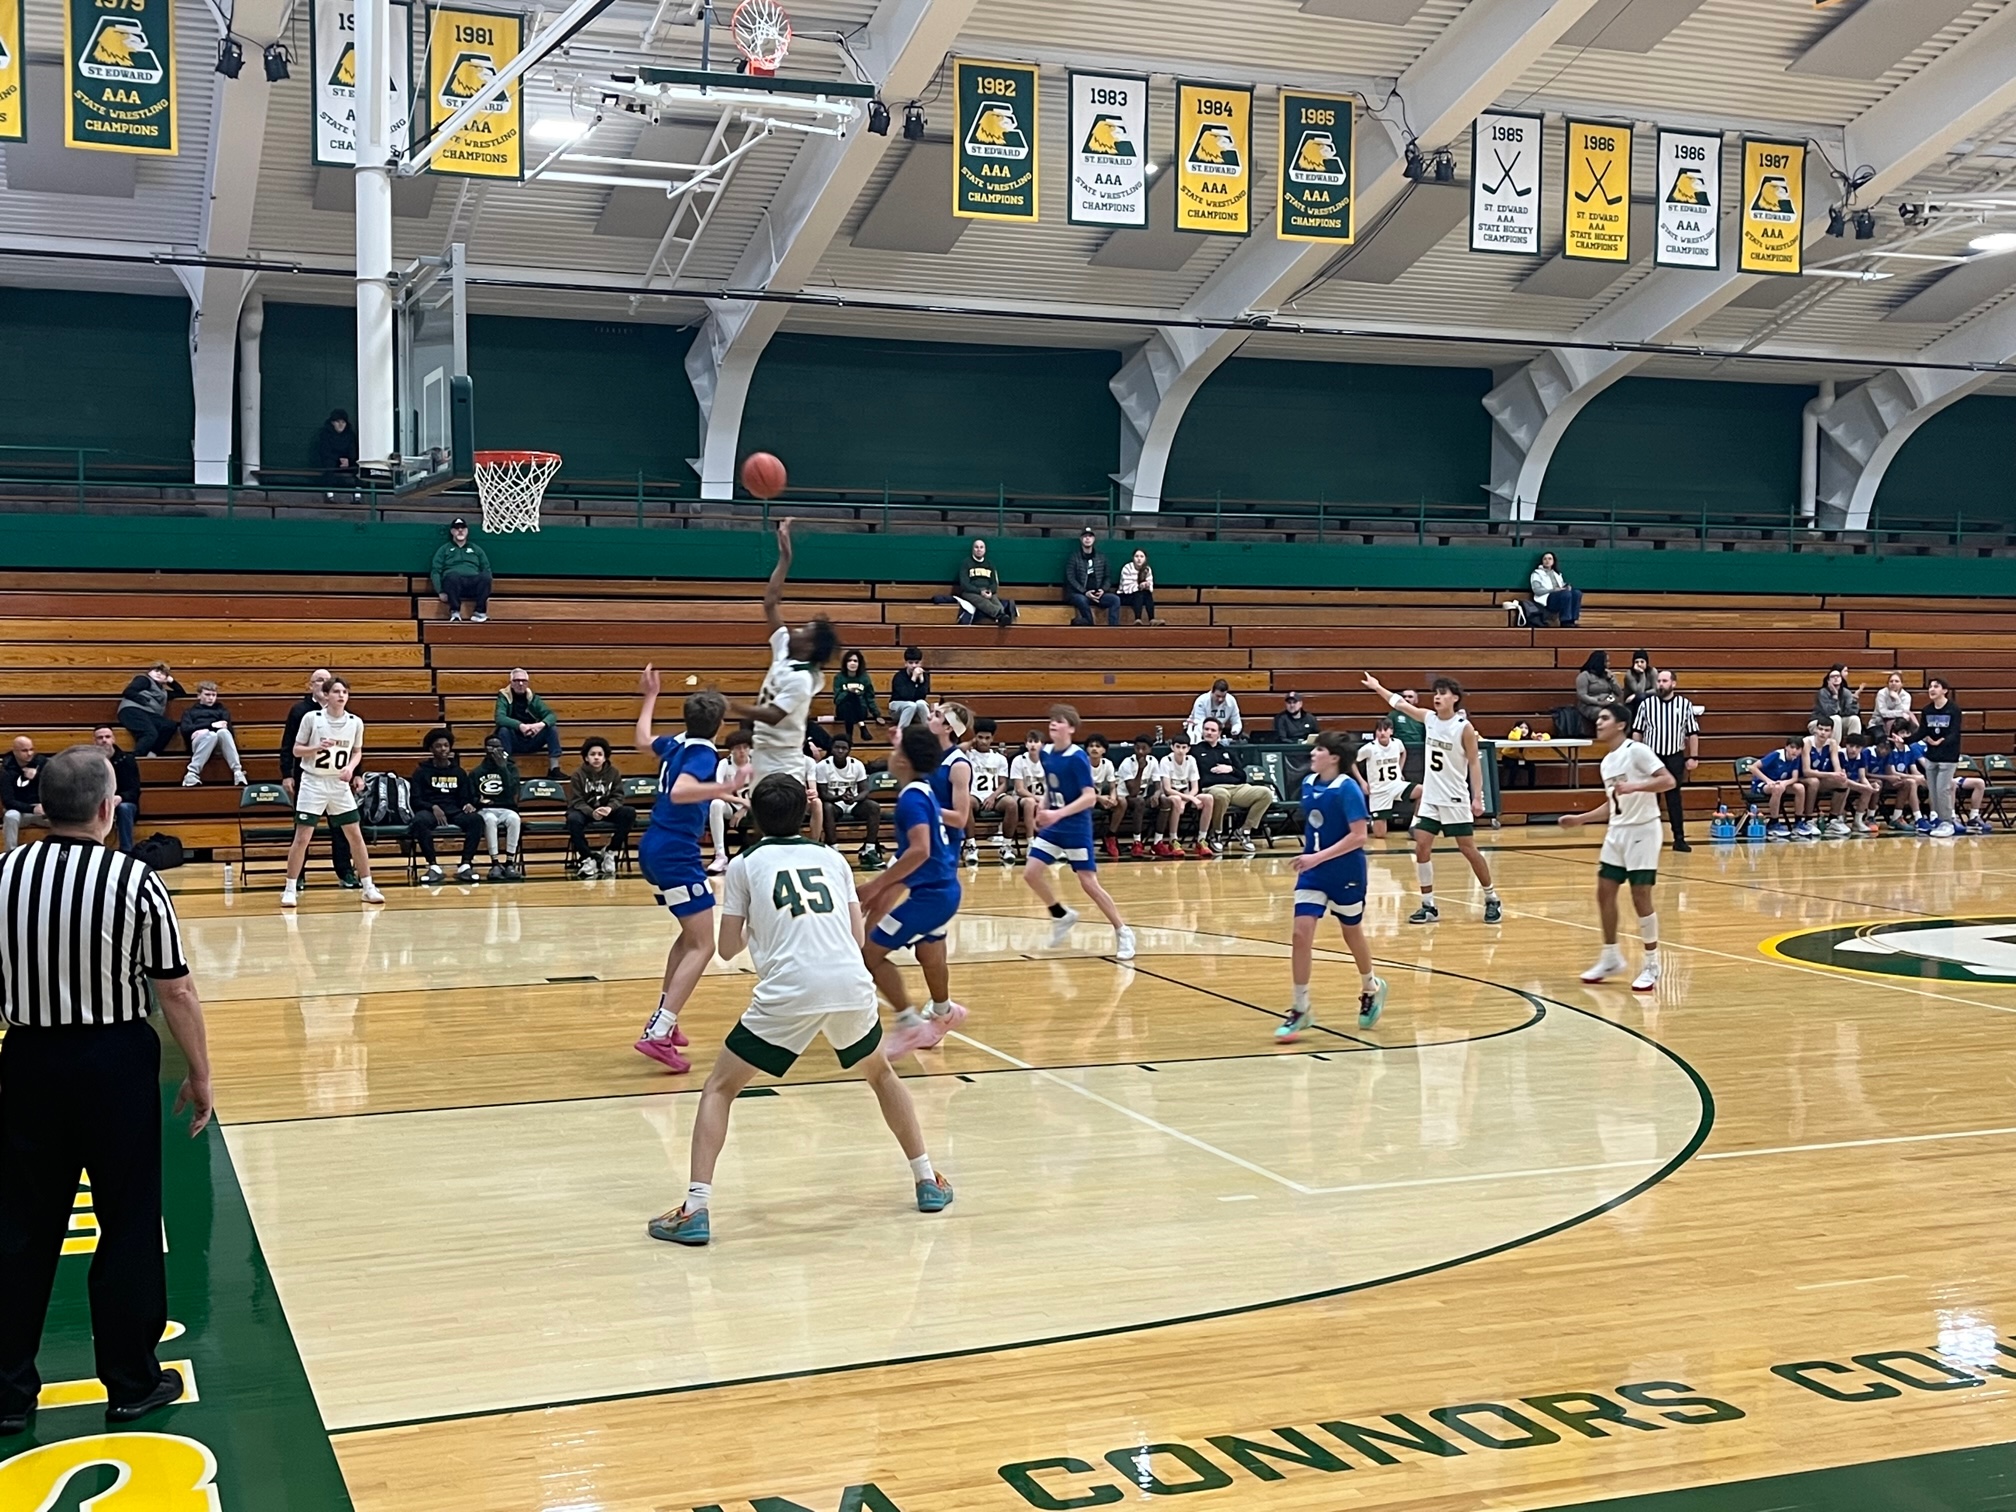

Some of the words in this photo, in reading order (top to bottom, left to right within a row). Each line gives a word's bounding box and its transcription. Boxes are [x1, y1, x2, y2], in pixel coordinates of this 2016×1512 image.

[455, 24, 494, 46] 1981
[88, 66, 102, 76] ST.
[105, 68, 153, 81] EDWARD
[977, 76, 1016, 97] 1982
[102, 87, 141, 104] AAA
[1091, 88, 1128, 106] 1983
[74, 90, 105, 115] STATE
[109, 98, 169, 121] WRESTLING
[446, 98, 459, 108] ST.
[1197, 99, 1233, 117] 1984
[319, 111, 349, 135] STATE
[1301, 108, 1335, 126] 1985
[85, 119, 159, 136] CHAMPIONS
[1492, 126, 1523, 143] 1985
[465, 128, 517, 148] WRESTLING
[1584, 135, 1615, 152] 1986
[442, 149, 508, 163] CHAMPIONS
[971, 145, 983, 154] ST.
[984, 147, 1021, 157] EDWARD
[1675, 144, 1705, 161] 1986
[1084, 155, 1096, 163] ST.
[1099, 157, 1132, 166] EDWARD
[1759, 153, 1789, 169] 1987
[981, 164, 1011, 178] AAA
[1191, 164, 1202, 172] ST.
[1204, 166, 1237, 175] EDWARD
[961, 166, 984, 188] STATE
[986, 172, 1032, 191] WRESTLING
[1094, 173, 1122, 186] AAA
[1305, 174, 1339, 183] EDWARD
[1074, 176, 1096, 196] STATE
[1100, 181, 1143, 199] WRESTLING
[1201, 181, 1228, 194] AAA
[968, 192, 1024, 205] CHAMPIONS
[1180, 185, 1203, 204] STATE
[1205, 190, 1247, 208] WRESTLING
[1302, 190, 1330, 202] AAA
[1082, 201, 1136, 212] CHAMPIONS
[1284, 192, 1305, 213] STATE
[1307, 197, 1350, 215] WRESTLING
[1497, 204, 1528, 214] EDWARD
[1680, 205, 1707, 214] EDWARD
[1187, 209, 1239, 221] CHAMPIONS
[1290, 216, 1341, 228] CHAMPIONS
[1497, 215, 1515, 223] AAA
[1588, 213, 1619, 222] EDWARD
[1765, 213, 1791, 222] EDWARD
[1478, 223, 1501, 232] STATE
[1503, 225, 1534, 235] HOCKEY
[1588, 223, 1605, 231] AAA
[1660, 222, 1678, 241] STATE
[1680, 228, 1715, 244] WRESTLING
[1676, 220, 1700, 232] AAA
[1483, 233, 1528, 244] CHAMPIONS
[1570, 231, 1592, 240] STATE
[1594, 232, 1624, 242] HOCKEY
[1745, 230, 1763, 248] STATE
[1765, 235, 1798, 251] WRESTLING
[1761, 228, 1784, 239] AAA
[1575, 241, 1618, 251] CHAMPIONS
[1666, 245, 1709, 256] CHAMPIONS
[1751, 252, 1793, 263] CHAMPIONS
[315, 749, 348, 769] 20
[1430, 751, 1443, 772] 5
[1378, 765, 1397, 782] 15
[1313, 832, 1320, 852] 1
[772, 867, 834, 918] 45
[998, 1381, 1746, 1510] CONNORS
